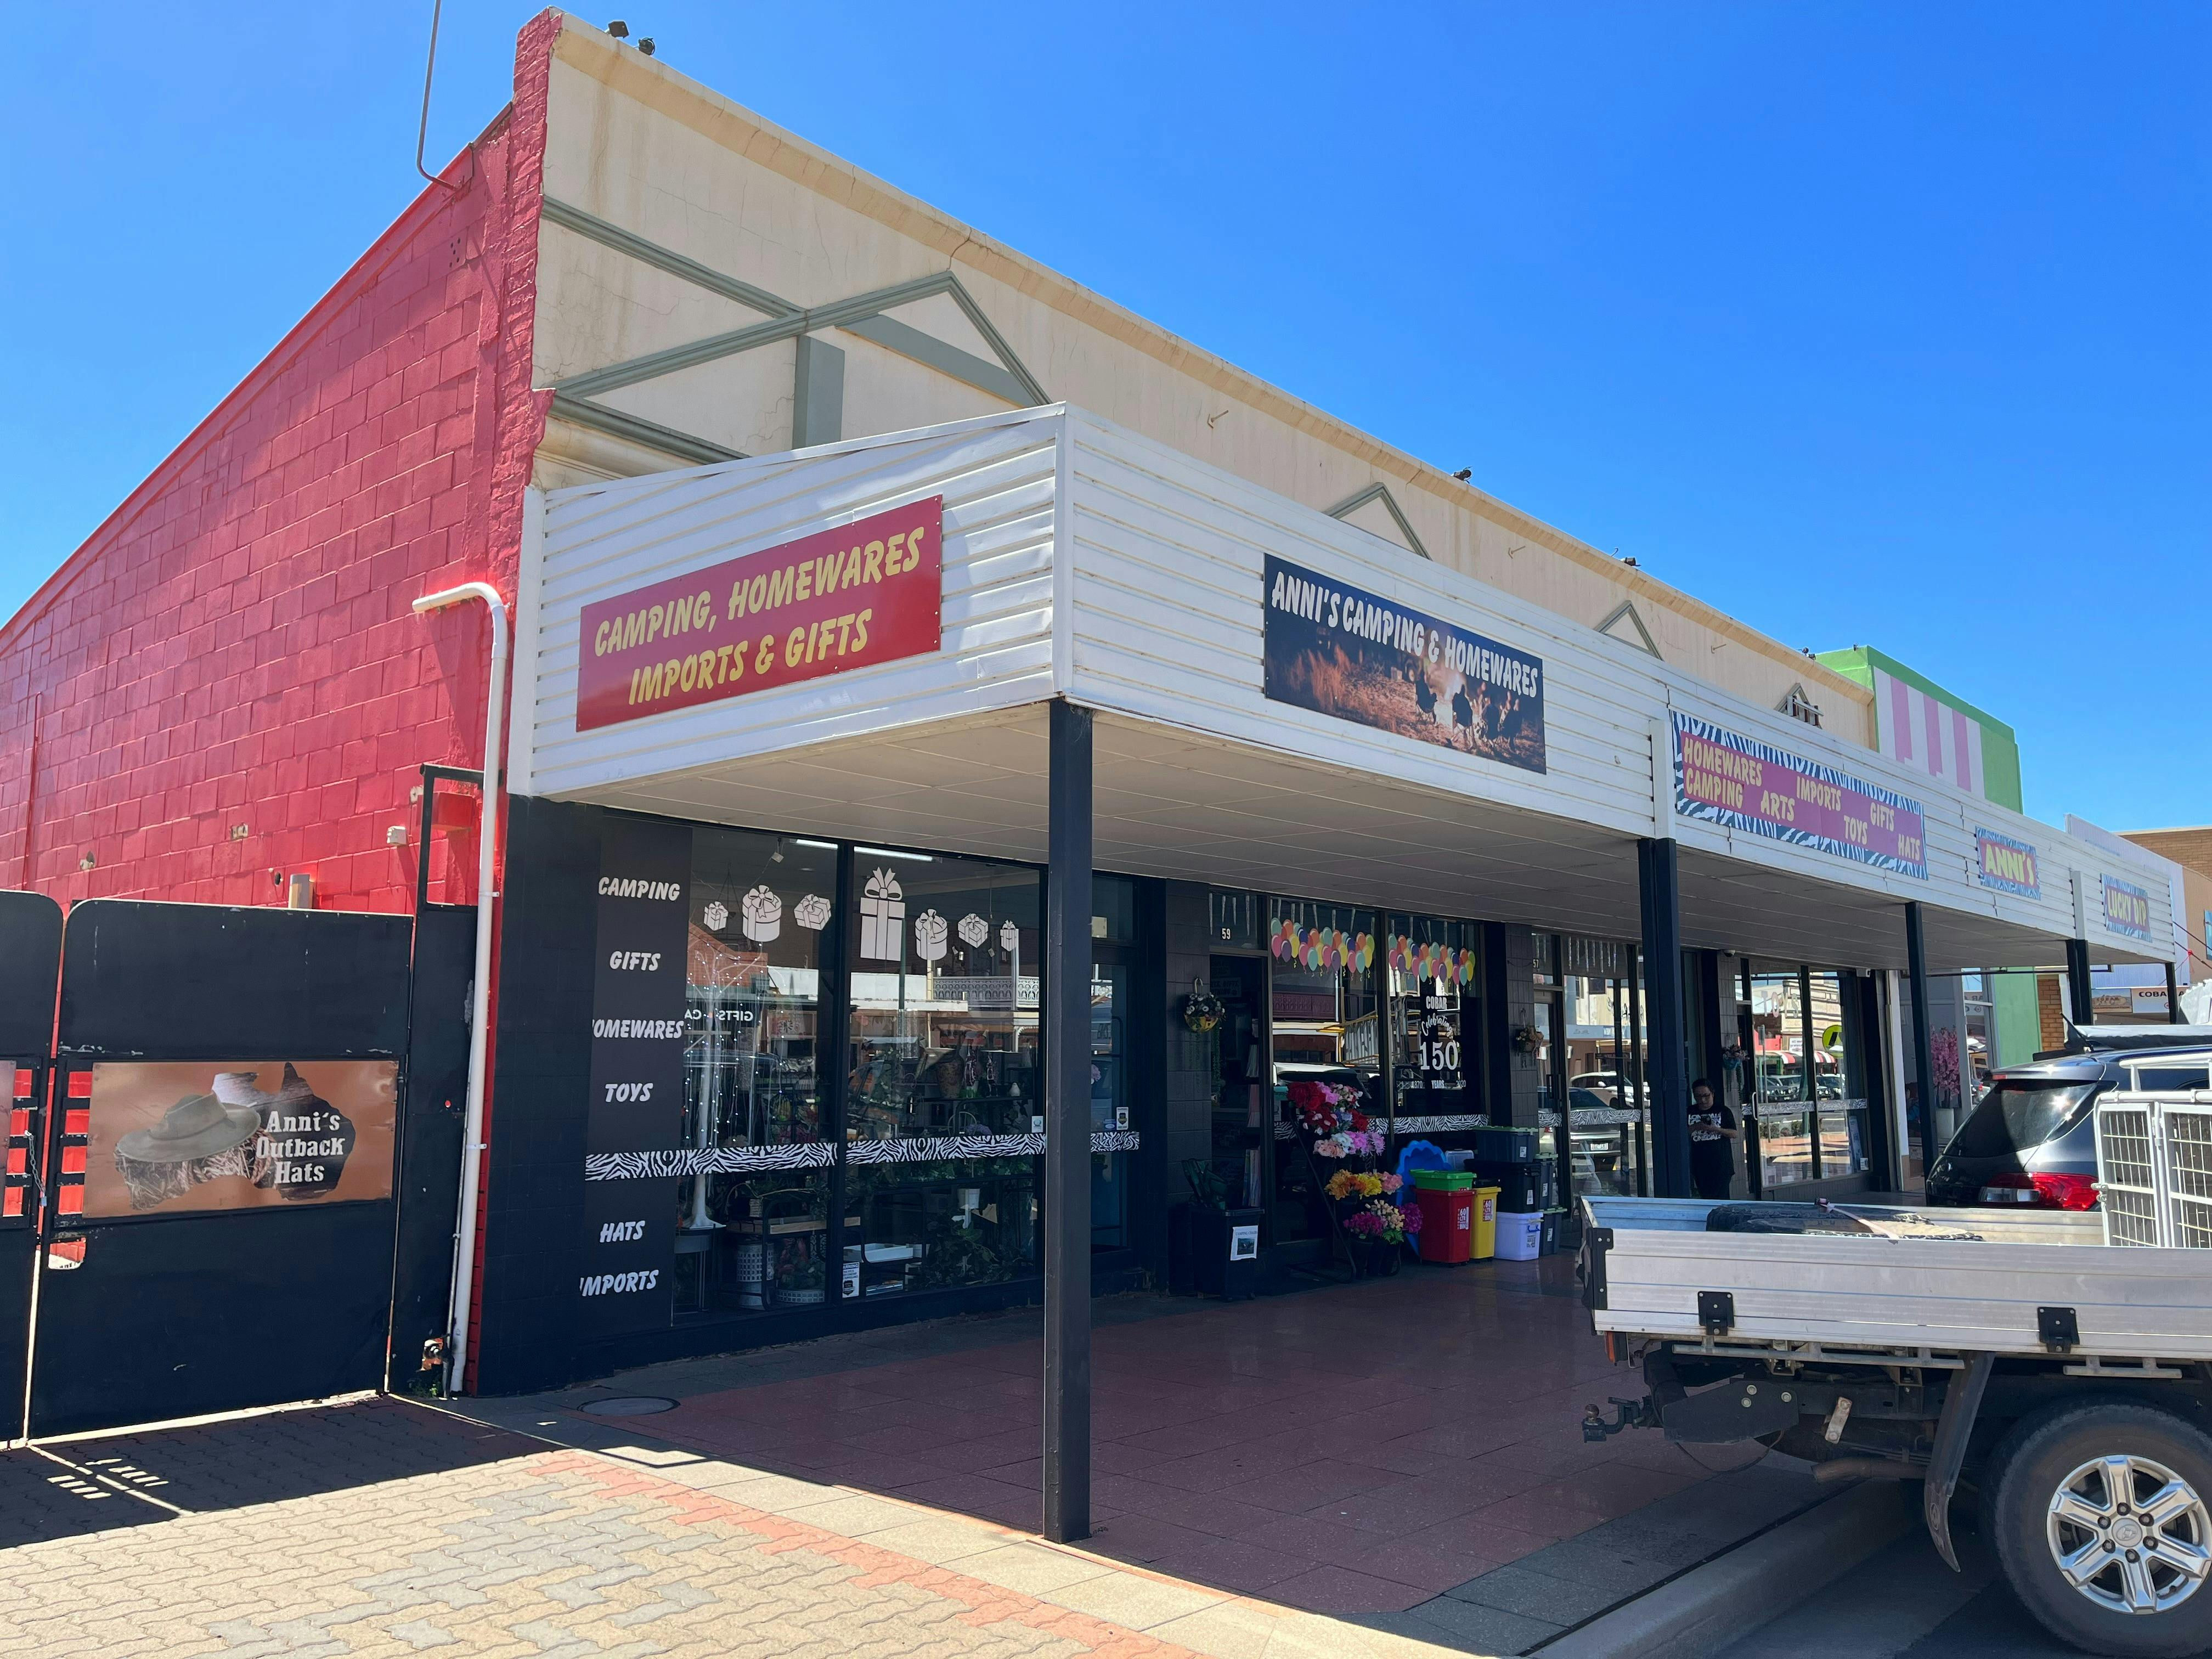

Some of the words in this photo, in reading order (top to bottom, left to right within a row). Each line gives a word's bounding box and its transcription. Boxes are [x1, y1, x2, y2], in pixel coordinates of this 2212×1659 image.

[595, 590, 718, 657] CAMPING,
[727, 526, 924, 620] HOMEWARES
[1272, 571, 1340, 628] ANNI'S
[1342, 596, 1425, 657] CAMPING
[1428, 630, 1440, 663] &
[1444, 634, 1538, 697] HOMEWARES
[628, 640, 747, 706] IMPORTS
[754, 634, 775, 675] &
[785, 608, 873, 668] GIFTS
[1684, 737, 1763, 787] HOMEWARES
[1796, 776, 1841, 811] IMPORTS
[1870, 802, 1895, 831] GIFTS
[1686, 767, 1743, 809] CAMPING
[1760, 789, 1795, 822] ARTS
[1844, 815, 1867, 845] TOYS
[1898, 833, 1921, 861] HATS
[1985, 844, 2034, 886] ANNI'S
[598, 877, 680, 901] CAMPING
[2107, 887, 2132, 923] LUCKY
[2134, 898, 2147, 927] DIP
[1222, 928, 1231, 940] 59
[609, 951, 661, 972] GIFTS
[1533, 959, 1539, 968] 57
[1426, 996, 1447, 1009] COBAR
[1762, 991, 1800, 1018] TOYS
[592, 1019, 684, 1040] OMEWARES
[1421, 1013, 1454, 1039] Celebrating
[1419, 1041, 1459, 1070] 150
[605, 1083, 653, 1103] TOYS
[1412, 1080, 1423, 1089] 1870
[1431, 1080, 1444, 1089] YEARS
[256, 1135, 346, 1160] Outback
[274, 1161, 325, 1185] Hats
[600, 1220, 646, 1243] HATS
